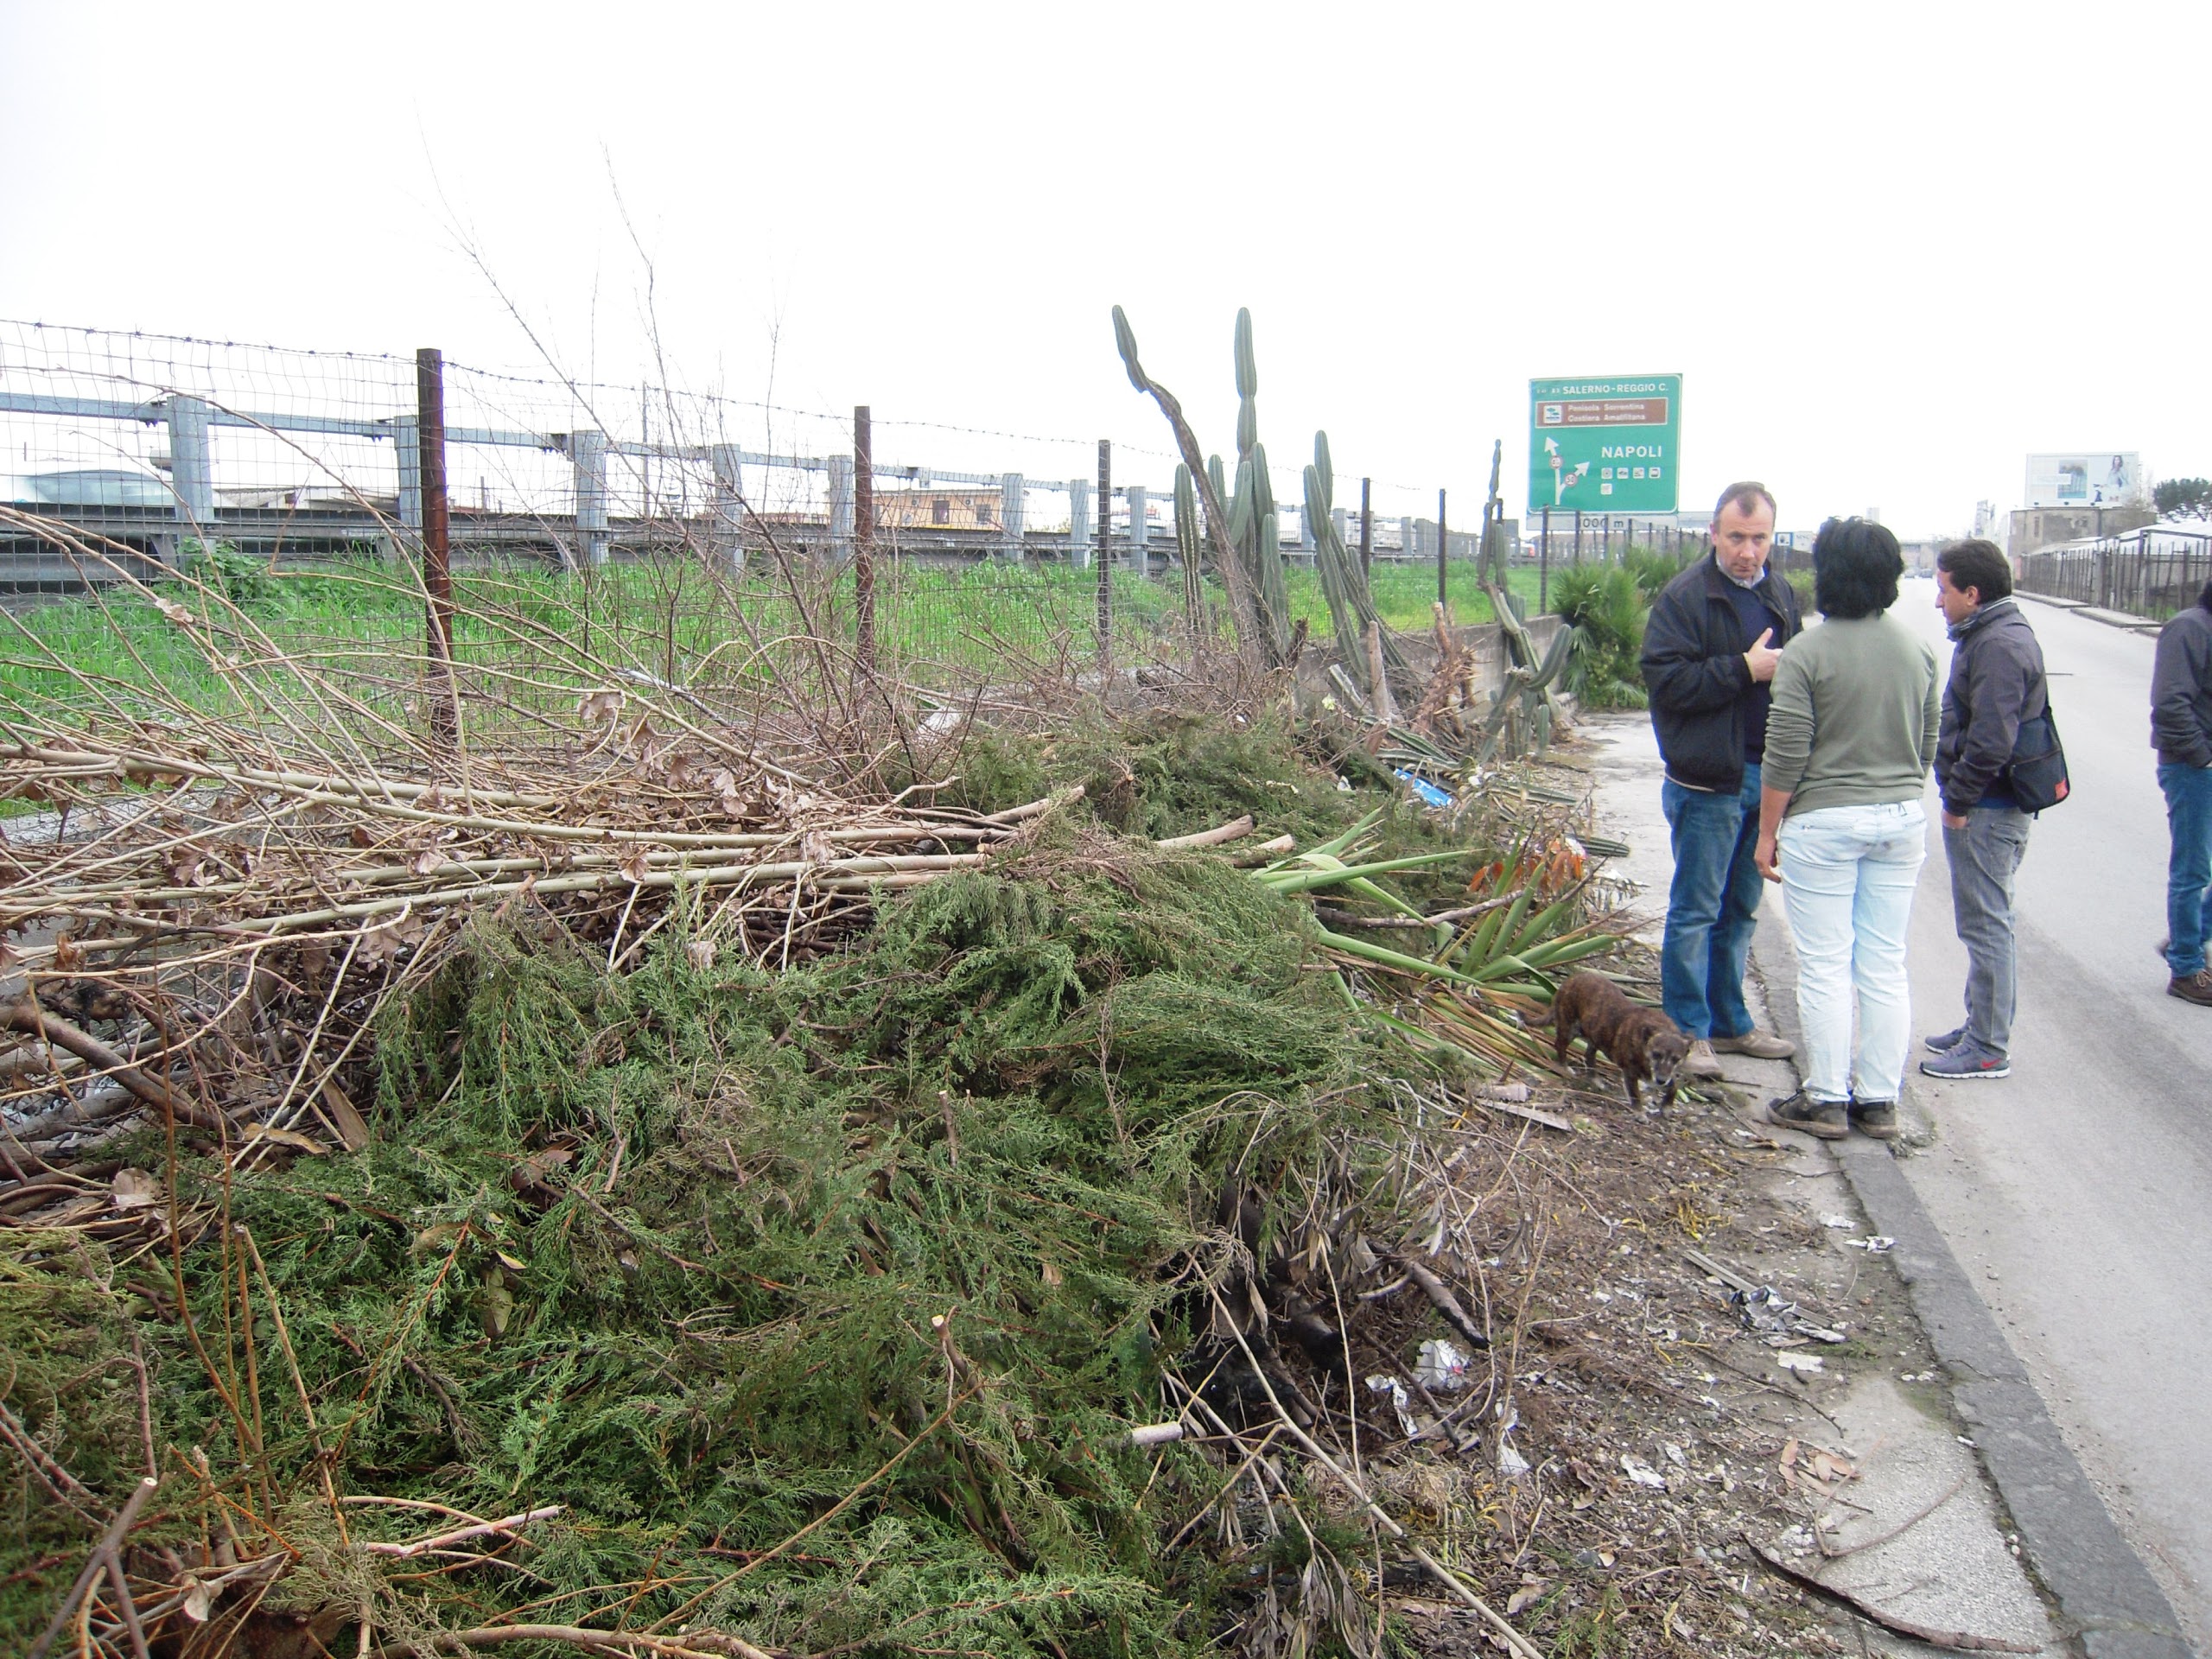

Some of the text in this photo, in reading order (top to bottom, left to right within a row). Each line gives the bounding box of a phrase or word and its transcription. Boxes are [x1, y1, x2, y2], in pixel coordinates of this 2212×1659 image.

[1562, 384, 1656, 395] SALERNO-REGGIO
[1658, 384, 1669, 392] C.
[1601, 445, 1662, 458] NAPOLI
